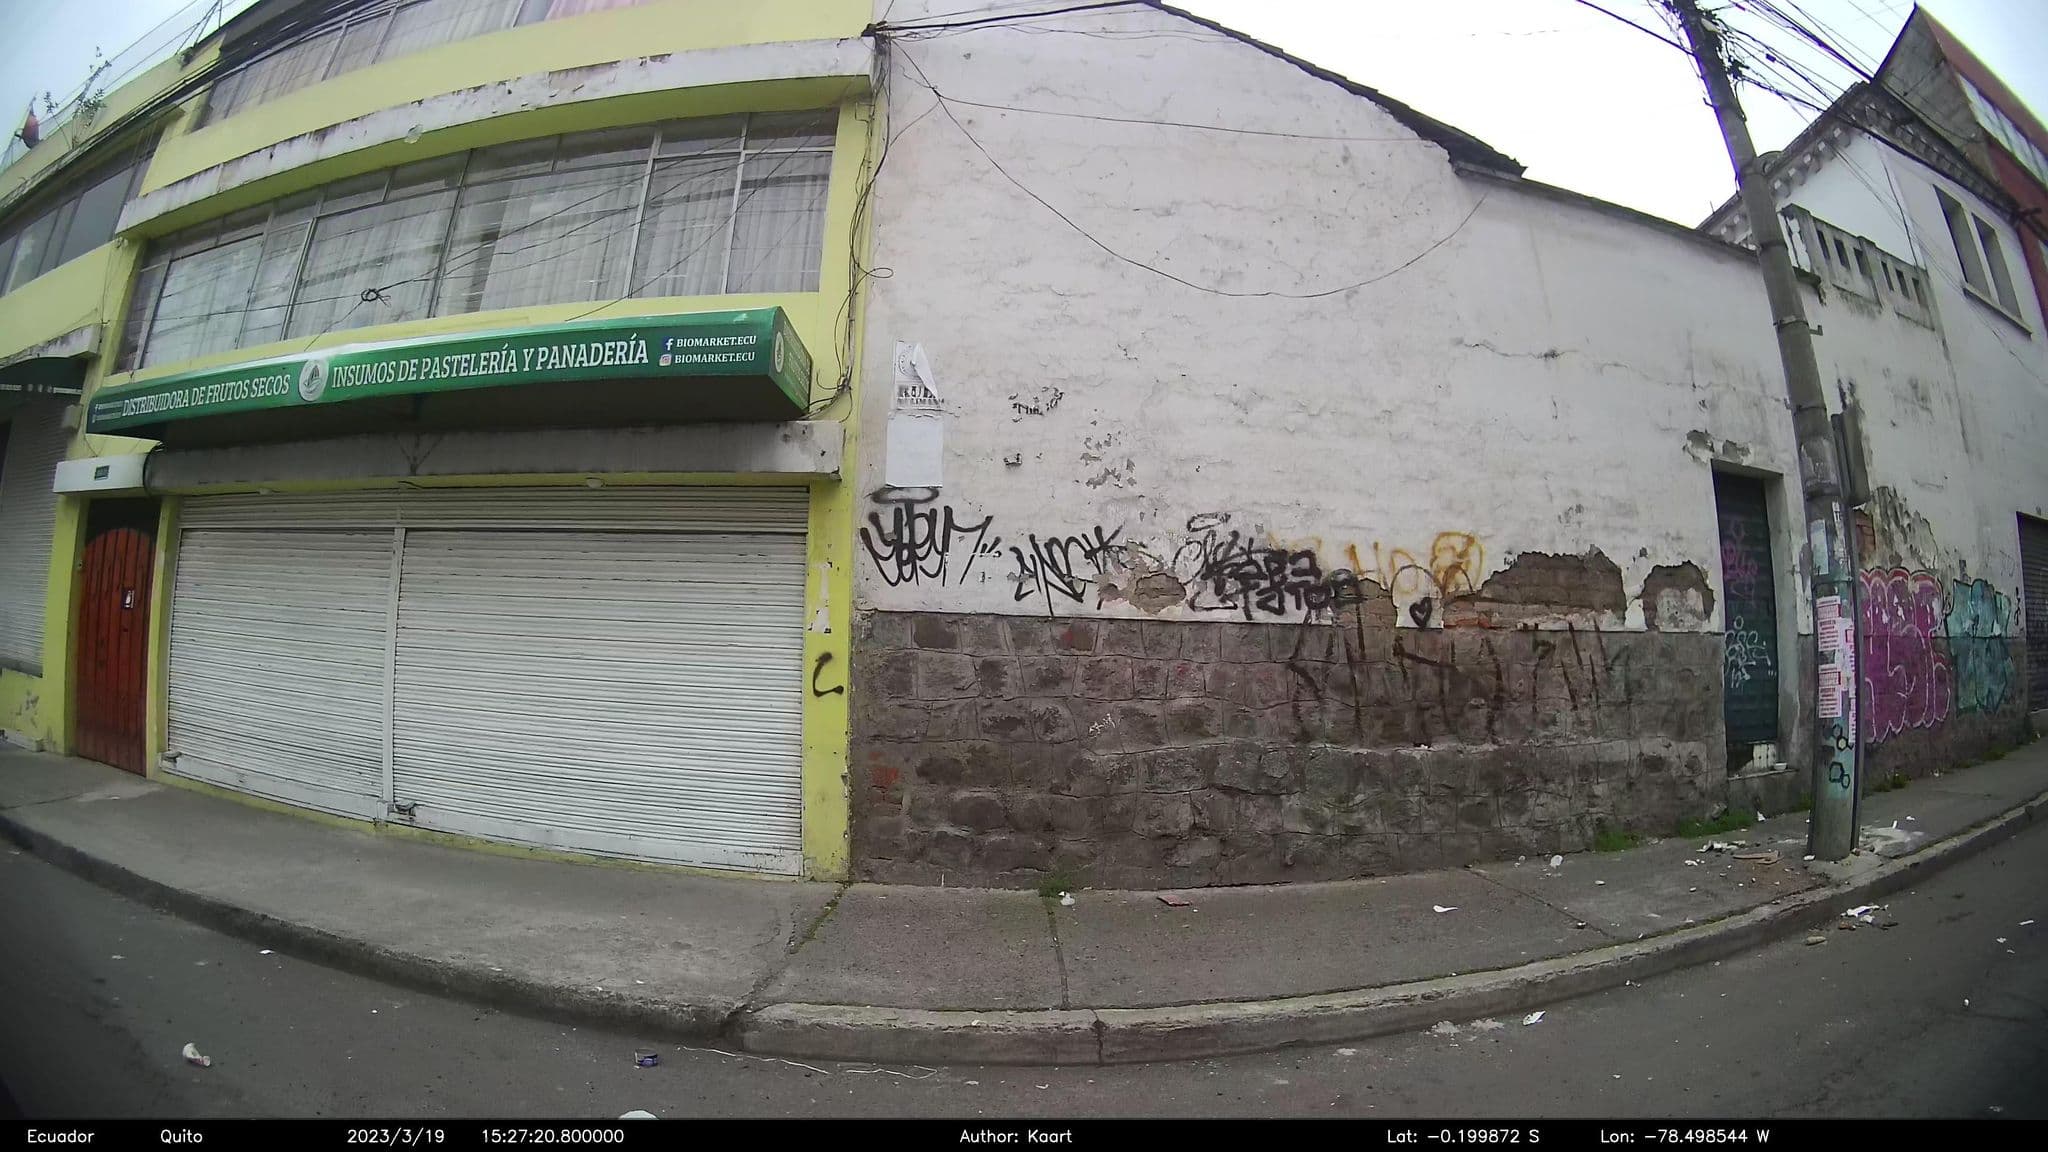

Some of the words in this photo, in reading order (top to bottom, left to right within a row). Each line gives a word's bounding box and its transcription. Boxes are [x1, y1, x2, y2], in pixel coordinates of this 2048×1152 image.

[676, 335, 757, 348] BIOMARKET.ECU
[331, 361, 397, 388] INSUMOS
[397, 358, 419, 382] DE
[419, 343, 519, 380] PASTELERÍA
[522, 347, 536, 372] Y
[535, 333, 649, 370] PANADERÍA
[674, 351, 756, 364] BIOMARKET.ECU
[122, 389, 189, 417] DISTRIBUIDORA
[191, 386, 205, 406] DE
[205, 379, 250, 404] FRUTOS
[250, 374, 291, 398] SECOS
